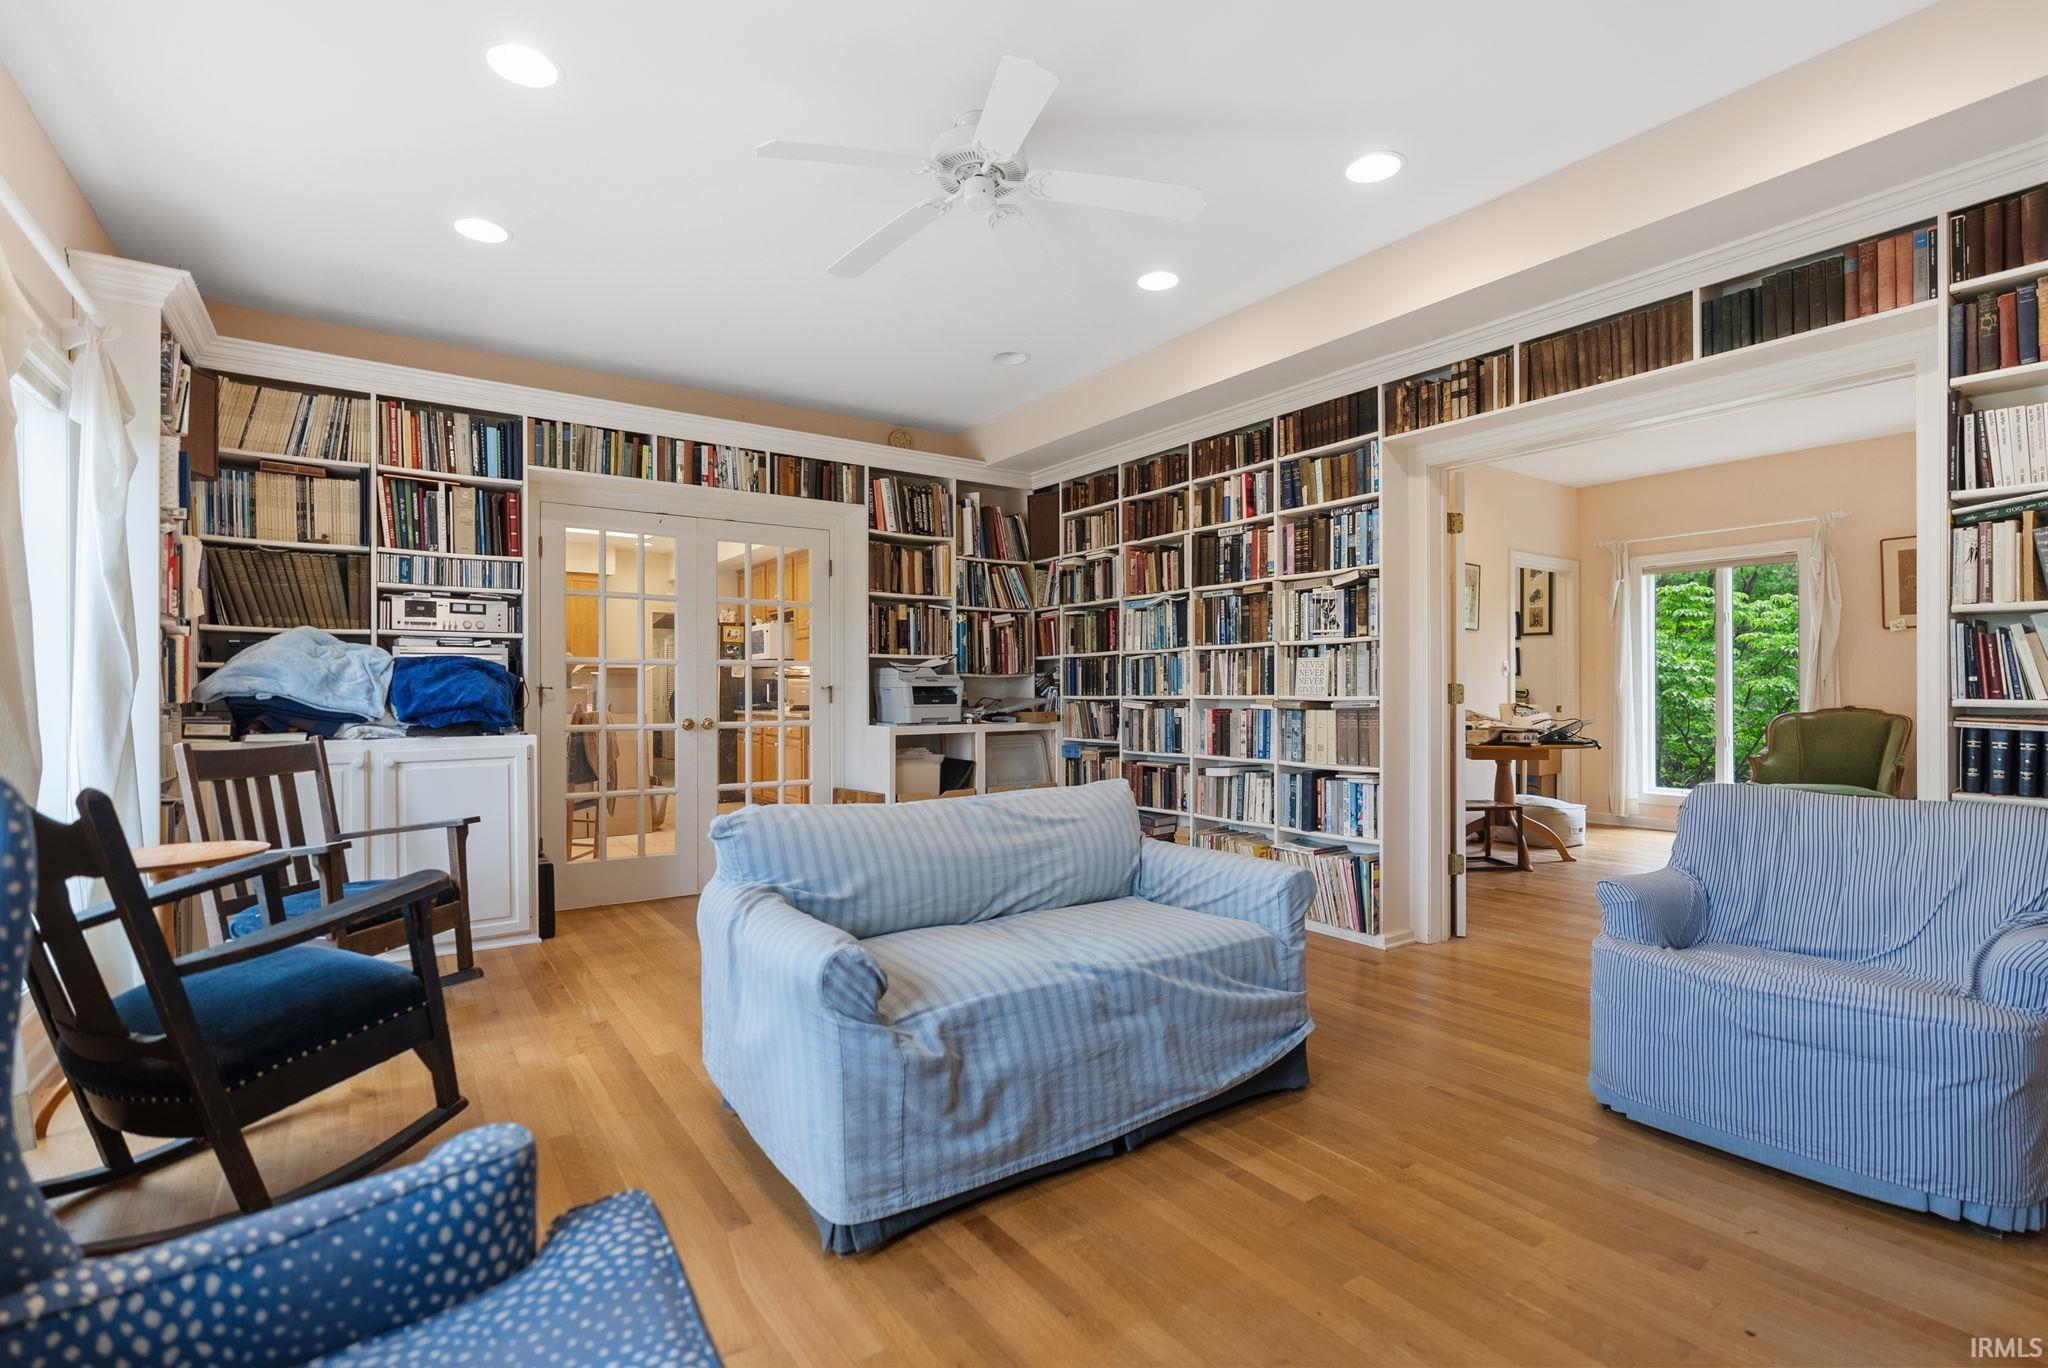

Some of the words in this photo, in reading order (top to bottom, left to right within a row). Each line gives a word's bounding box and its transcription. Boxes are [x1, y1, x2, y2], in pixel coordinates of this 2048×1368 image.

[1299, 660, 1326, 669] NEVER
[1299, 669, 1326, 677] NEVER
[1298, 677, 1325, 685] NEVER
[1298, 686, 1314, 694] GIVE
[1315, 686, 1325, 694] UP
